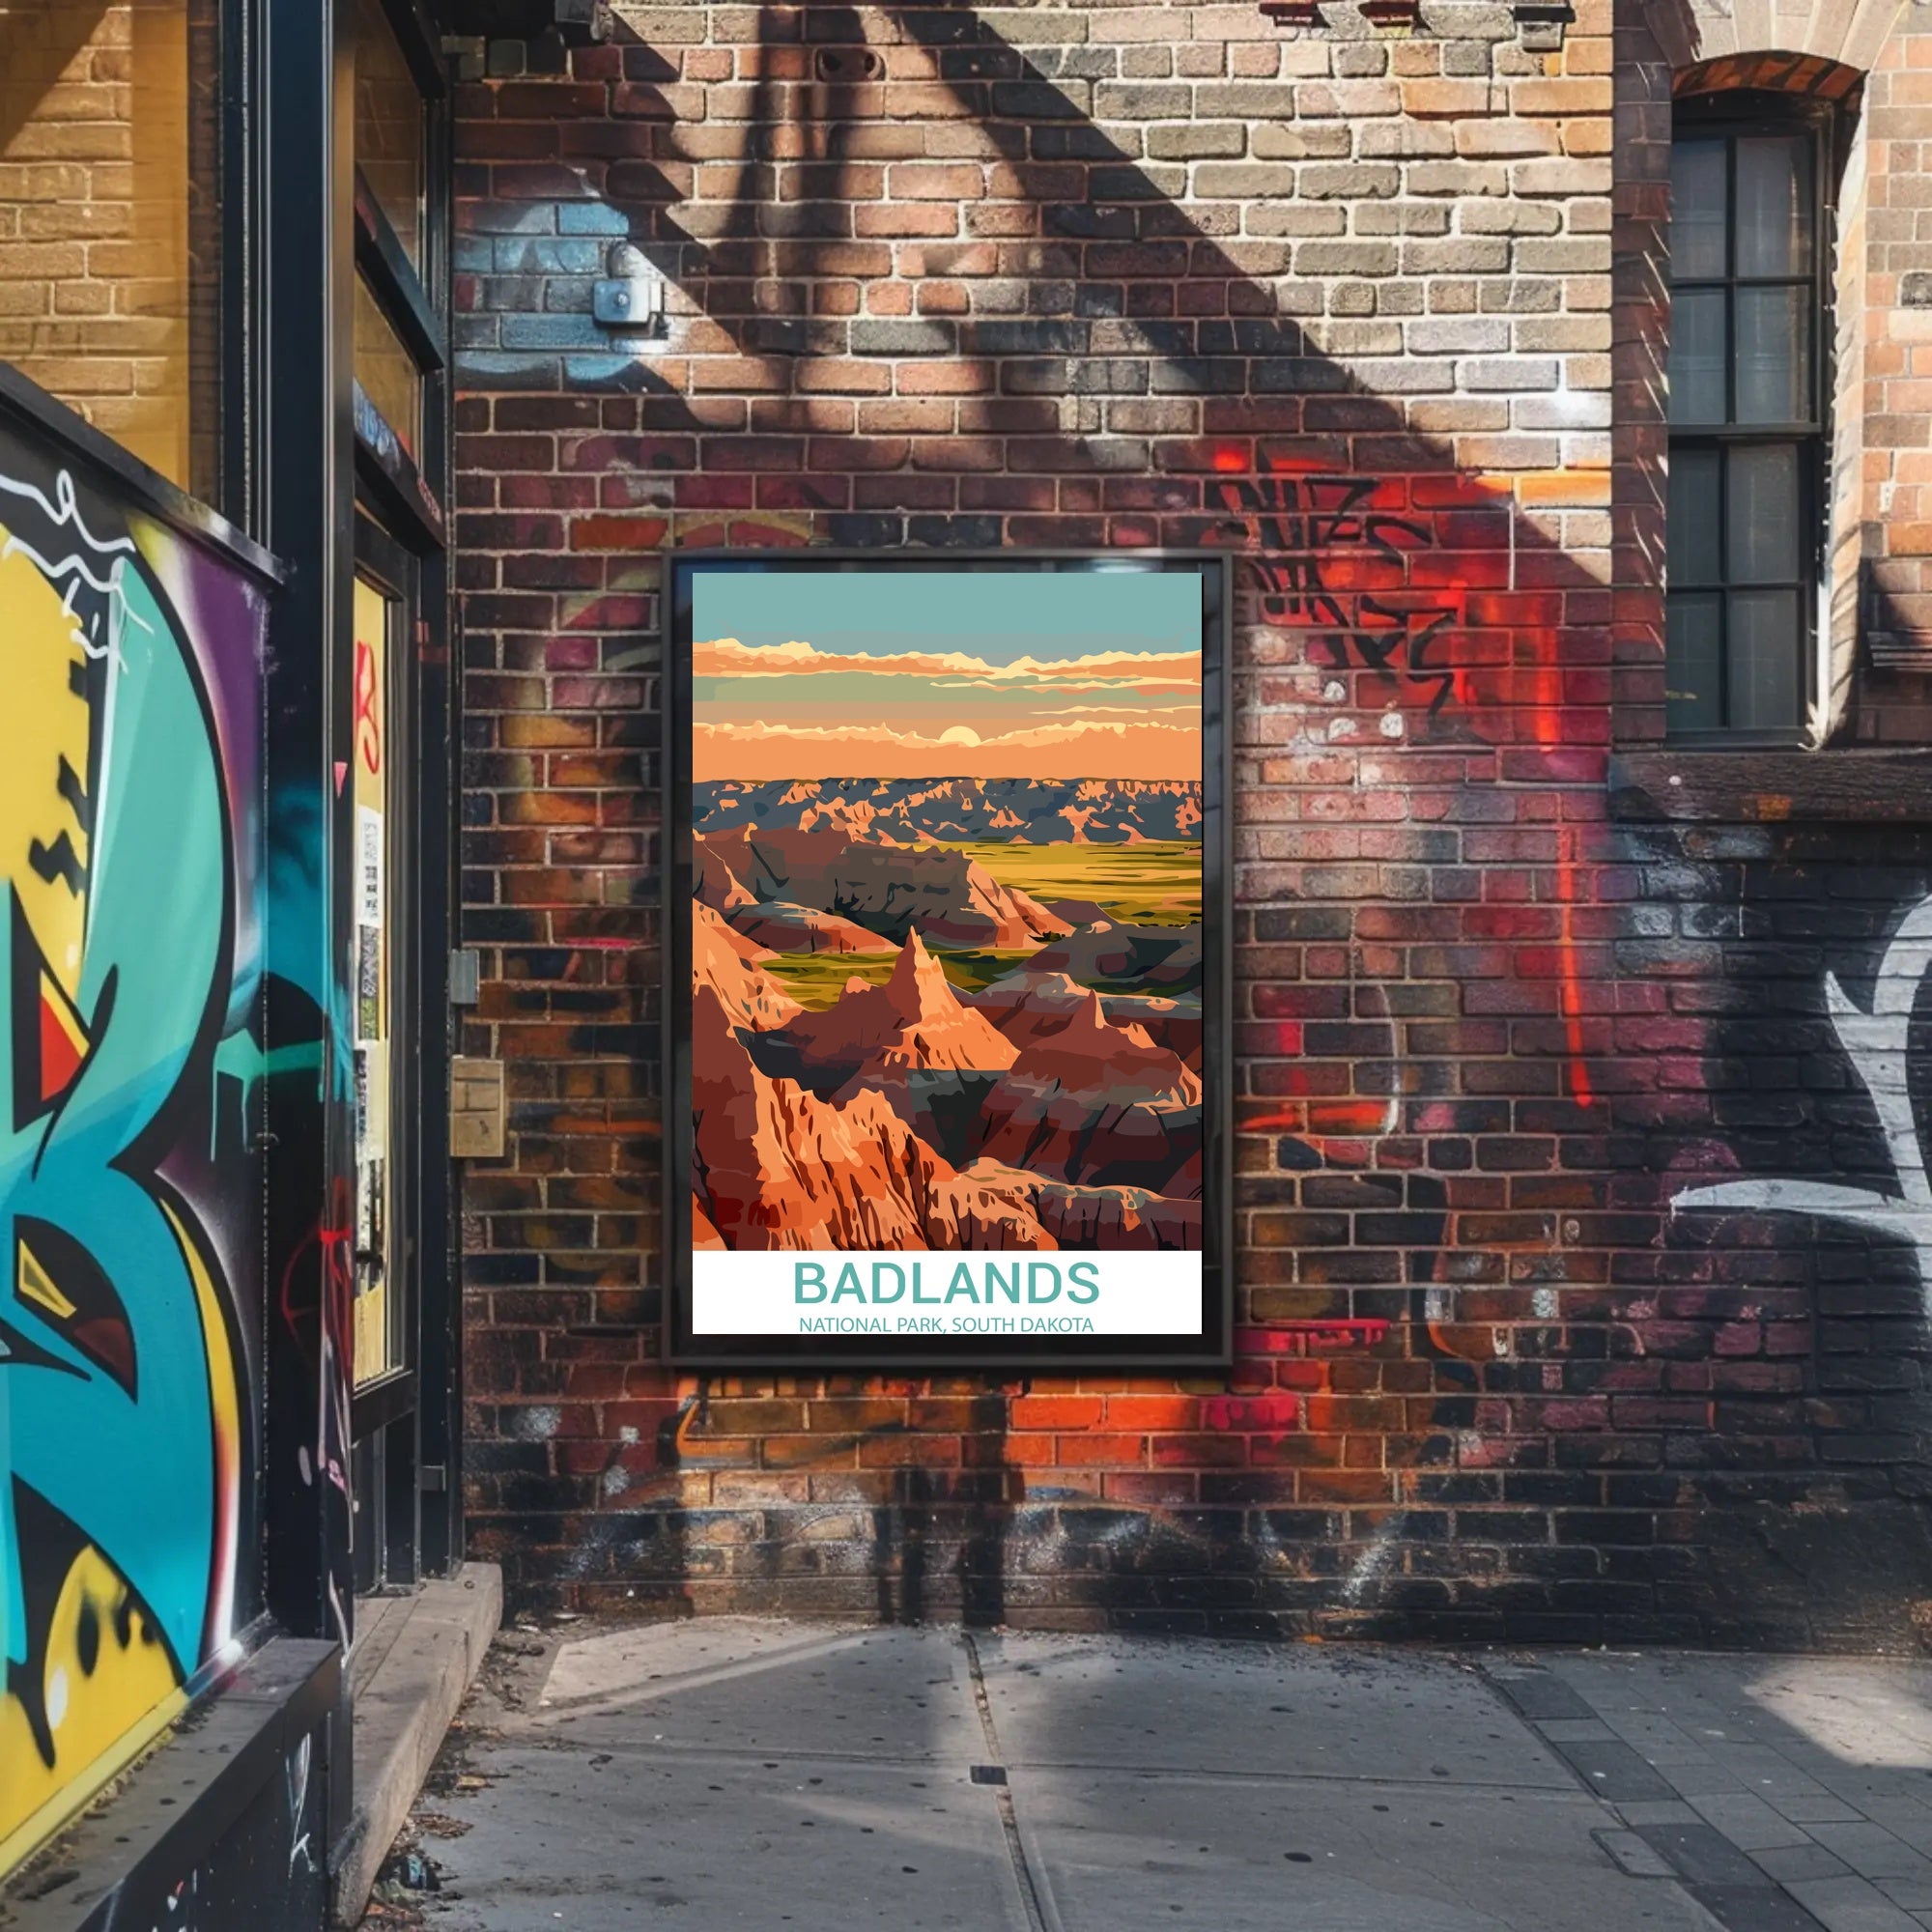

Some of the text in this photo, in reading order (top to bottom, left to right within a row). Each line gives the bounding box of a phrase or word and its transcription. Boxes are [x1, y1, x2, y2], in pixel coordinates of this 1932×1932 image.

[794, 1262, 1100, 1304] BADLANDS
[799, 1317, 1094, 1334] NATIONAL PARK, SOUTH DAKOTA
